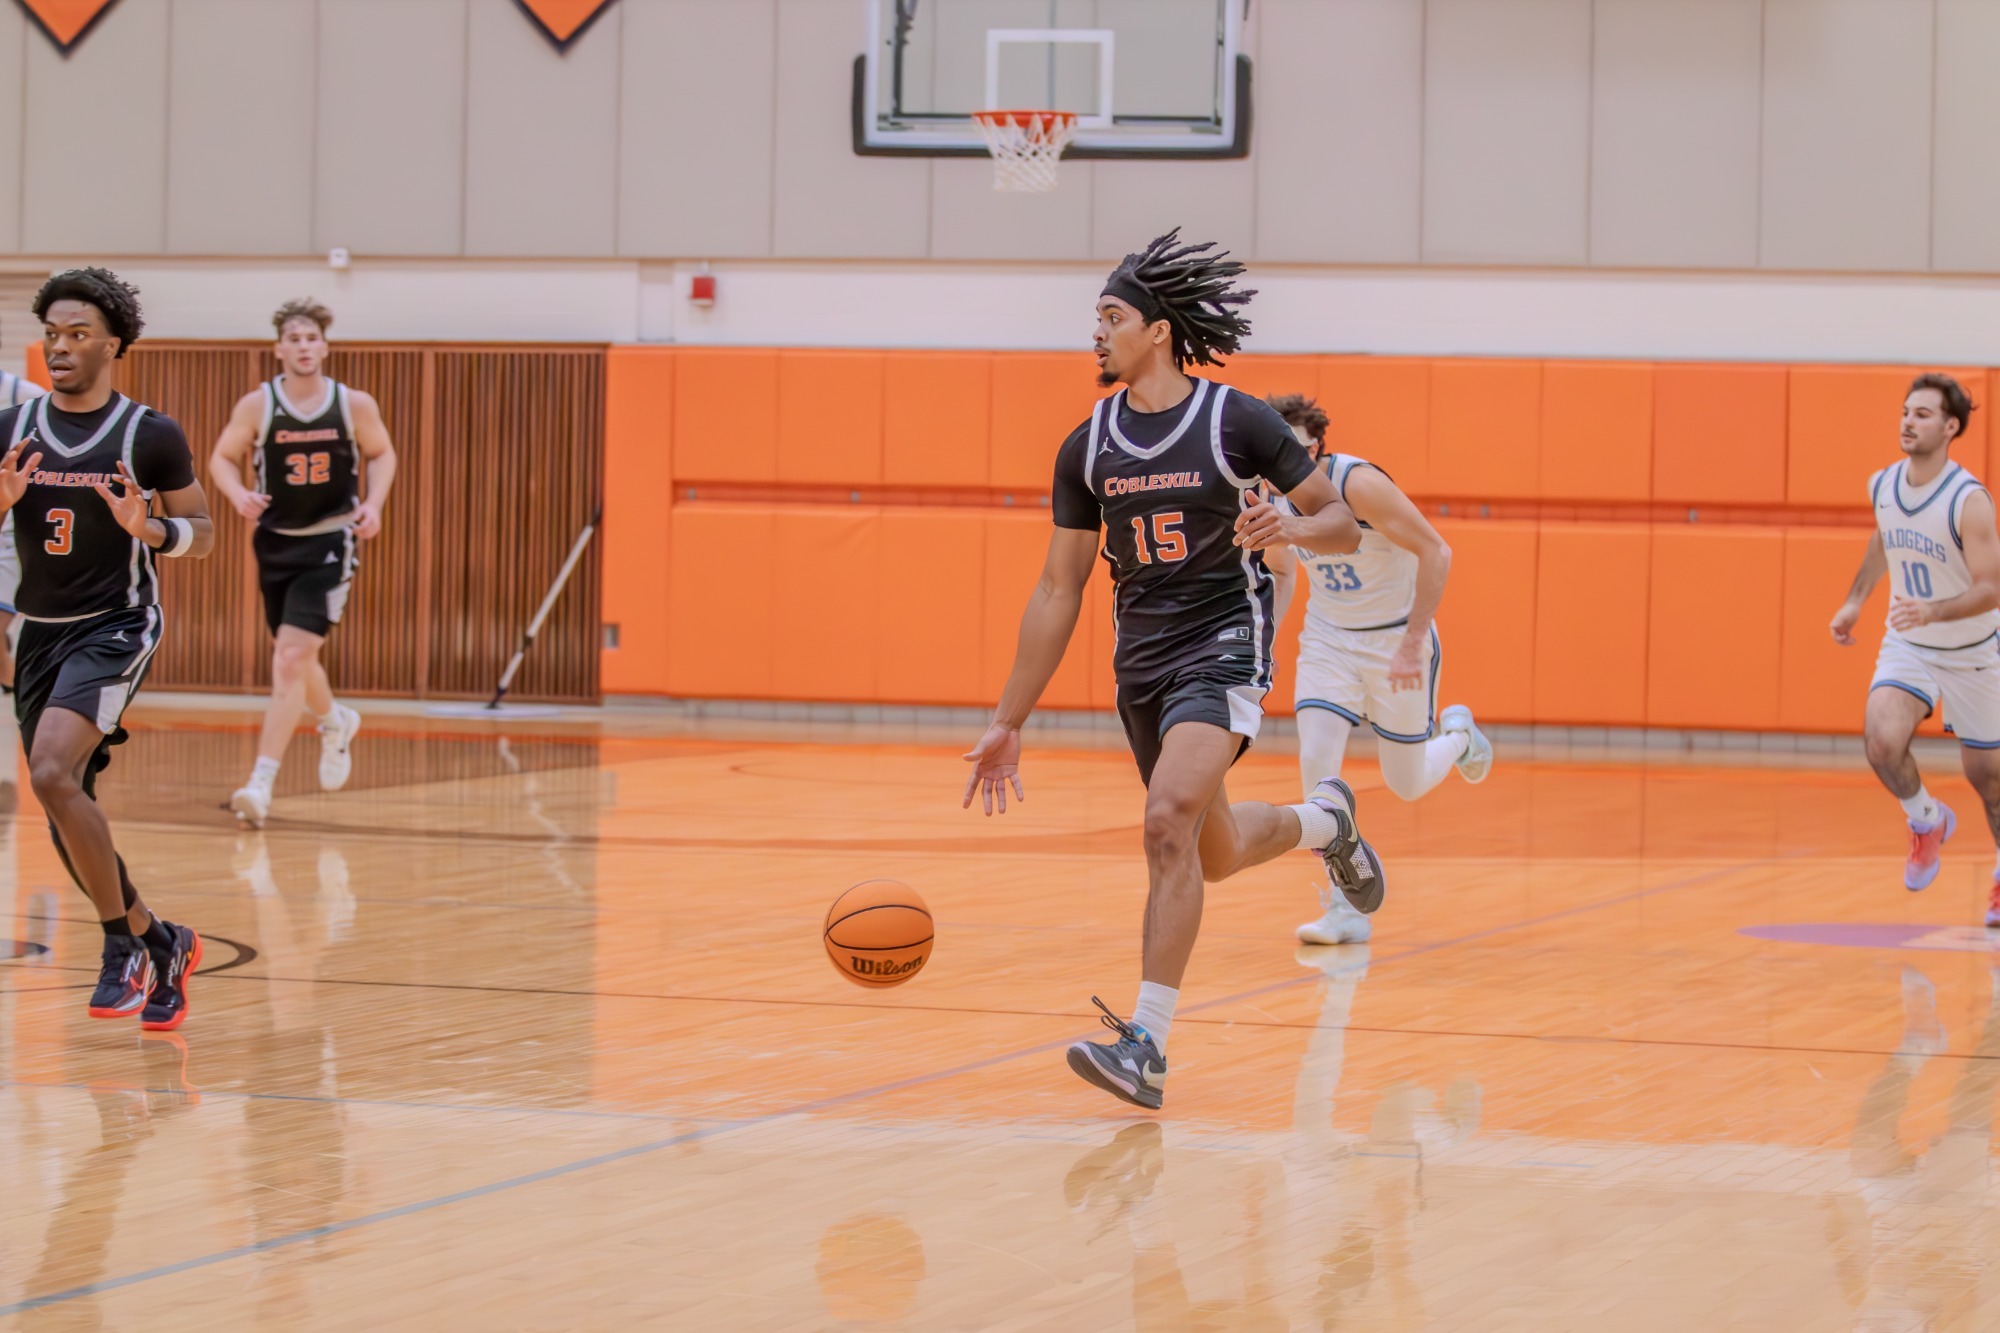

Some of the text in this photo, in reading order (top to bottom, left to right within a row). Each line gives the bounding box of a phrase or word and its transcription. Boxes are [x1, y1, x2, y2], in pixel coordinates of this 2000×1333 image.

[285, 452, 330, 485] 32
[1105, 472, 1202, 496] COBLESKILL
[45, 508, 75, 555] 3
[1131, 511, 1188, 564] 15
[1317, 563, 1362, 592] 33
[1901, 560, 1933, 599] 10
[851, 955, 922, 976] Wilson
